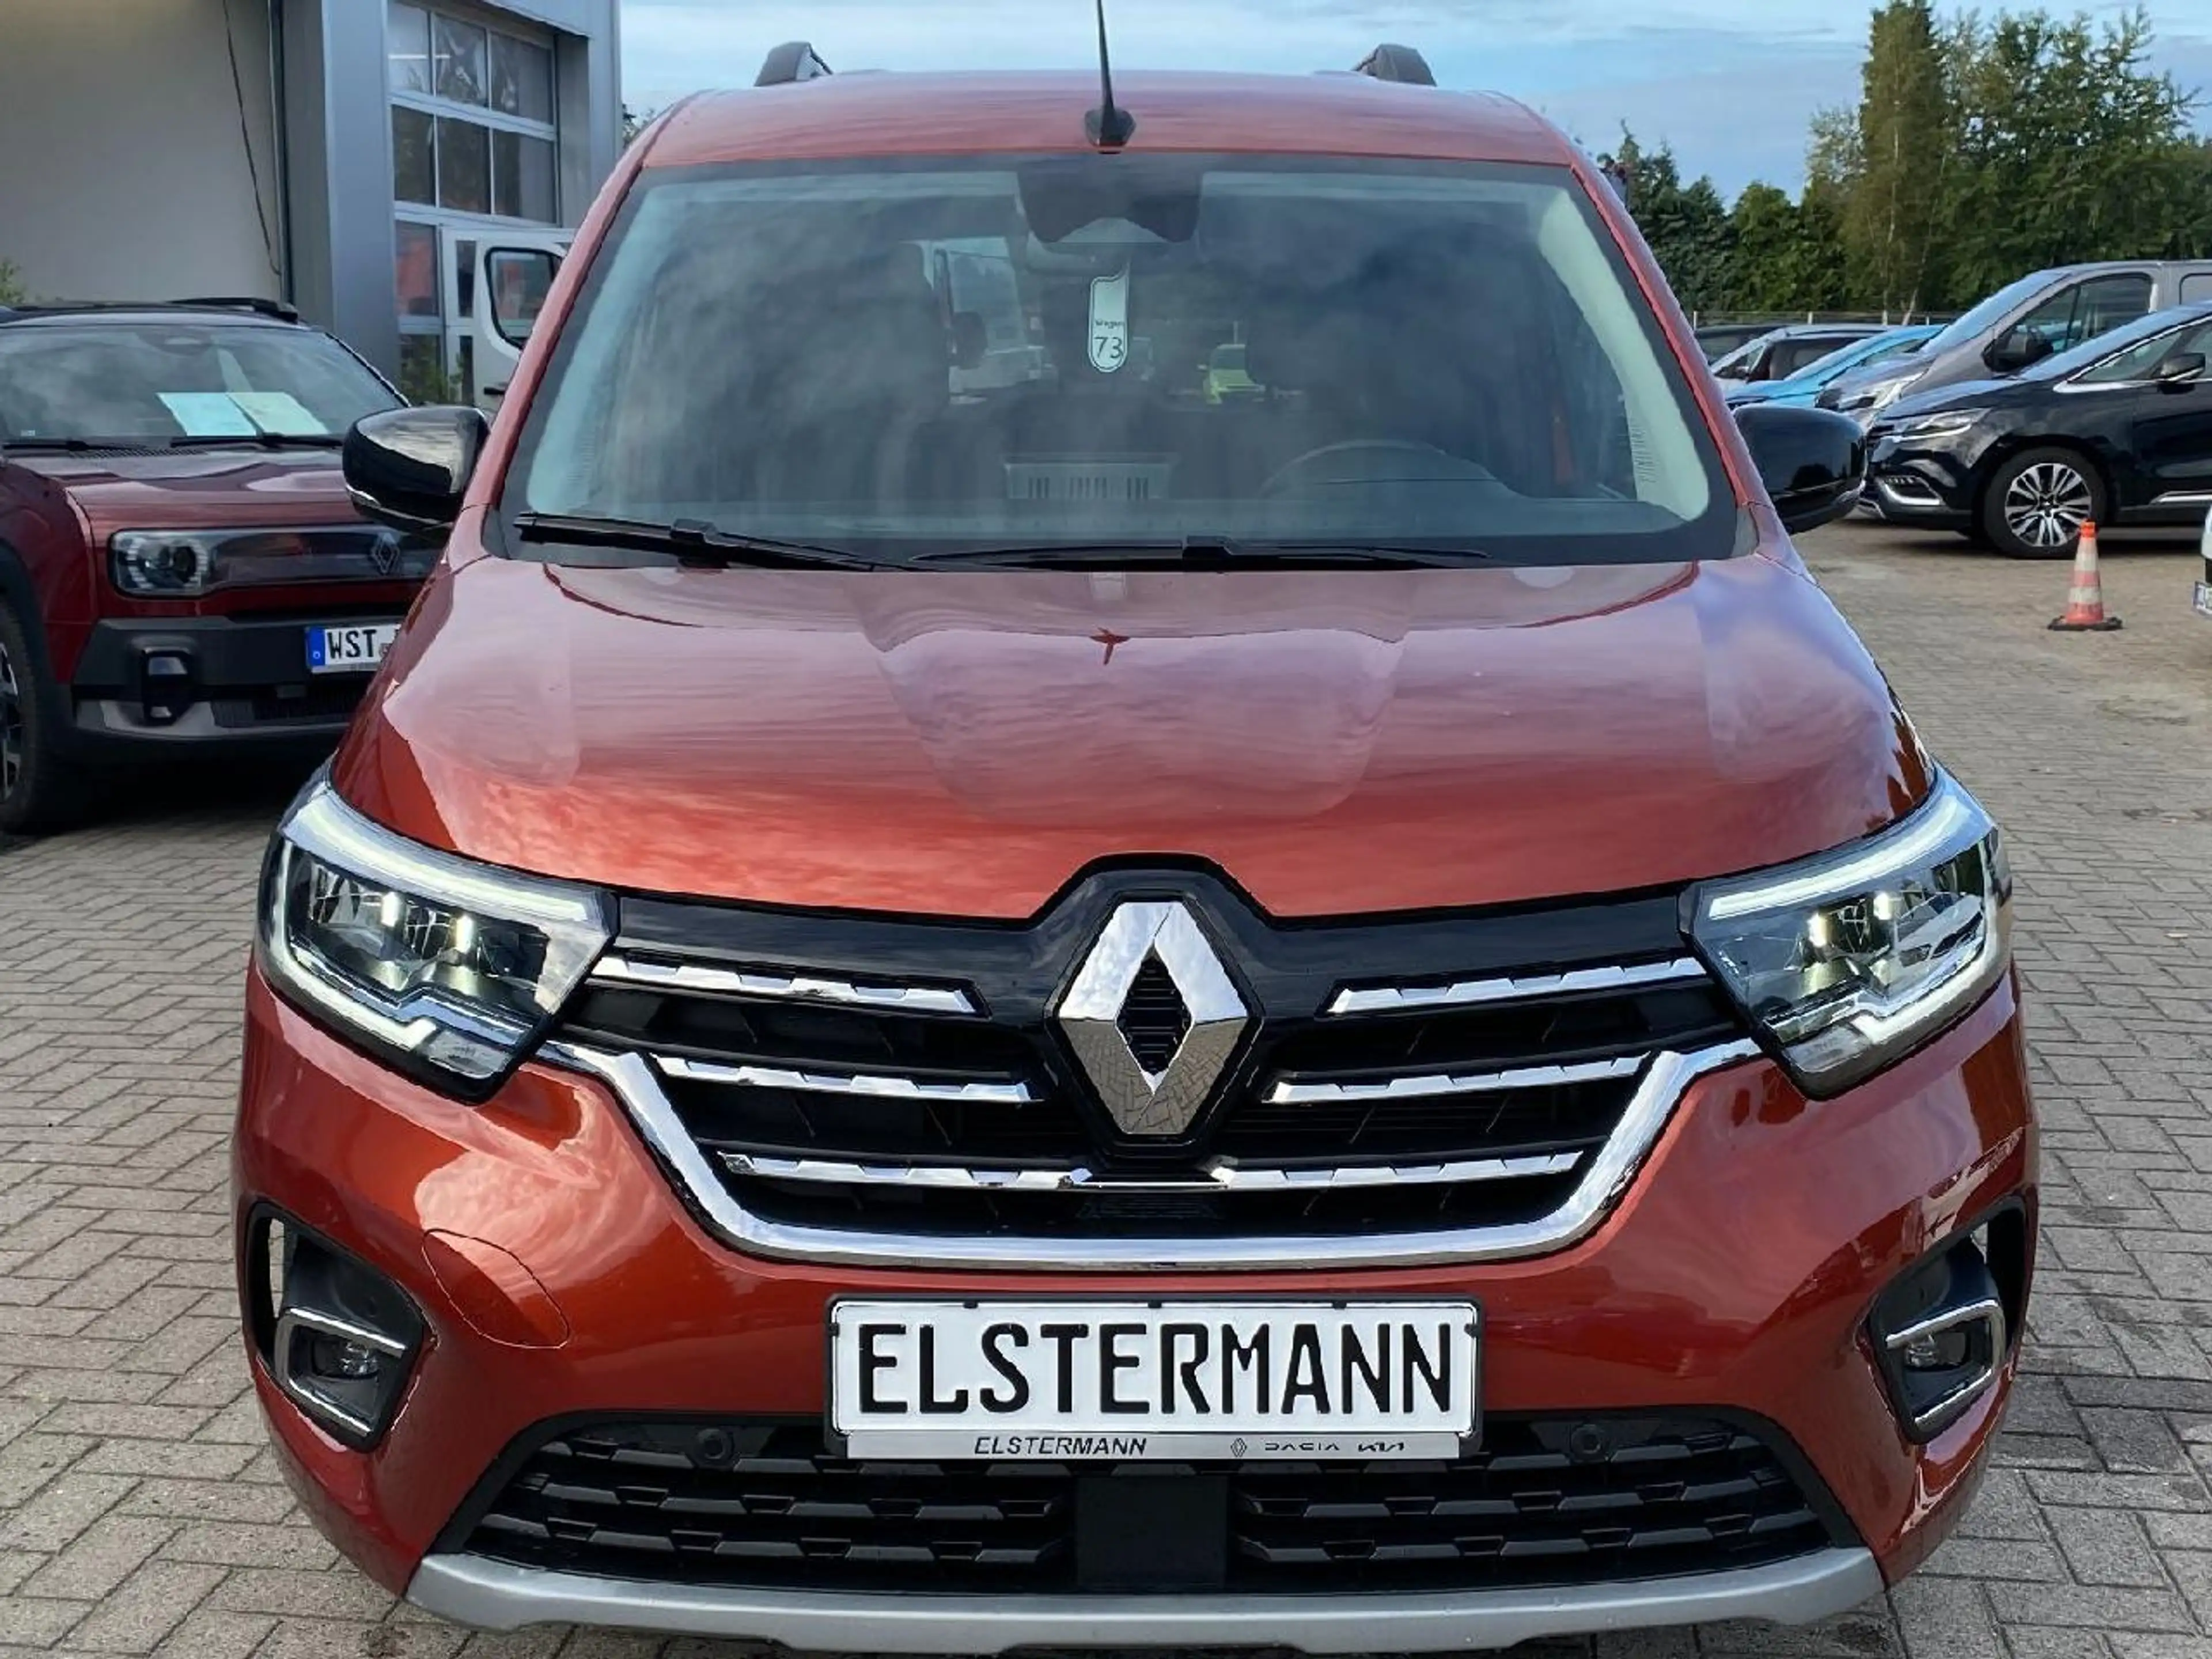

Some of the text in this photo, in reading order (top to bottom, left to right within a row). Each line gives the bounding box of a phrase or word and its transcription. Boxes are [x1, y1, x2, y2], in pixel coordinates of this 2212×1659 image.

[1094, 336, 1123, 358] 73
[327, 629, 377, 659] WST
[859, 1323, 1450, 1414] ELSTERMANN
[975, 1437, 1147, 1455] ELSTERMANN
